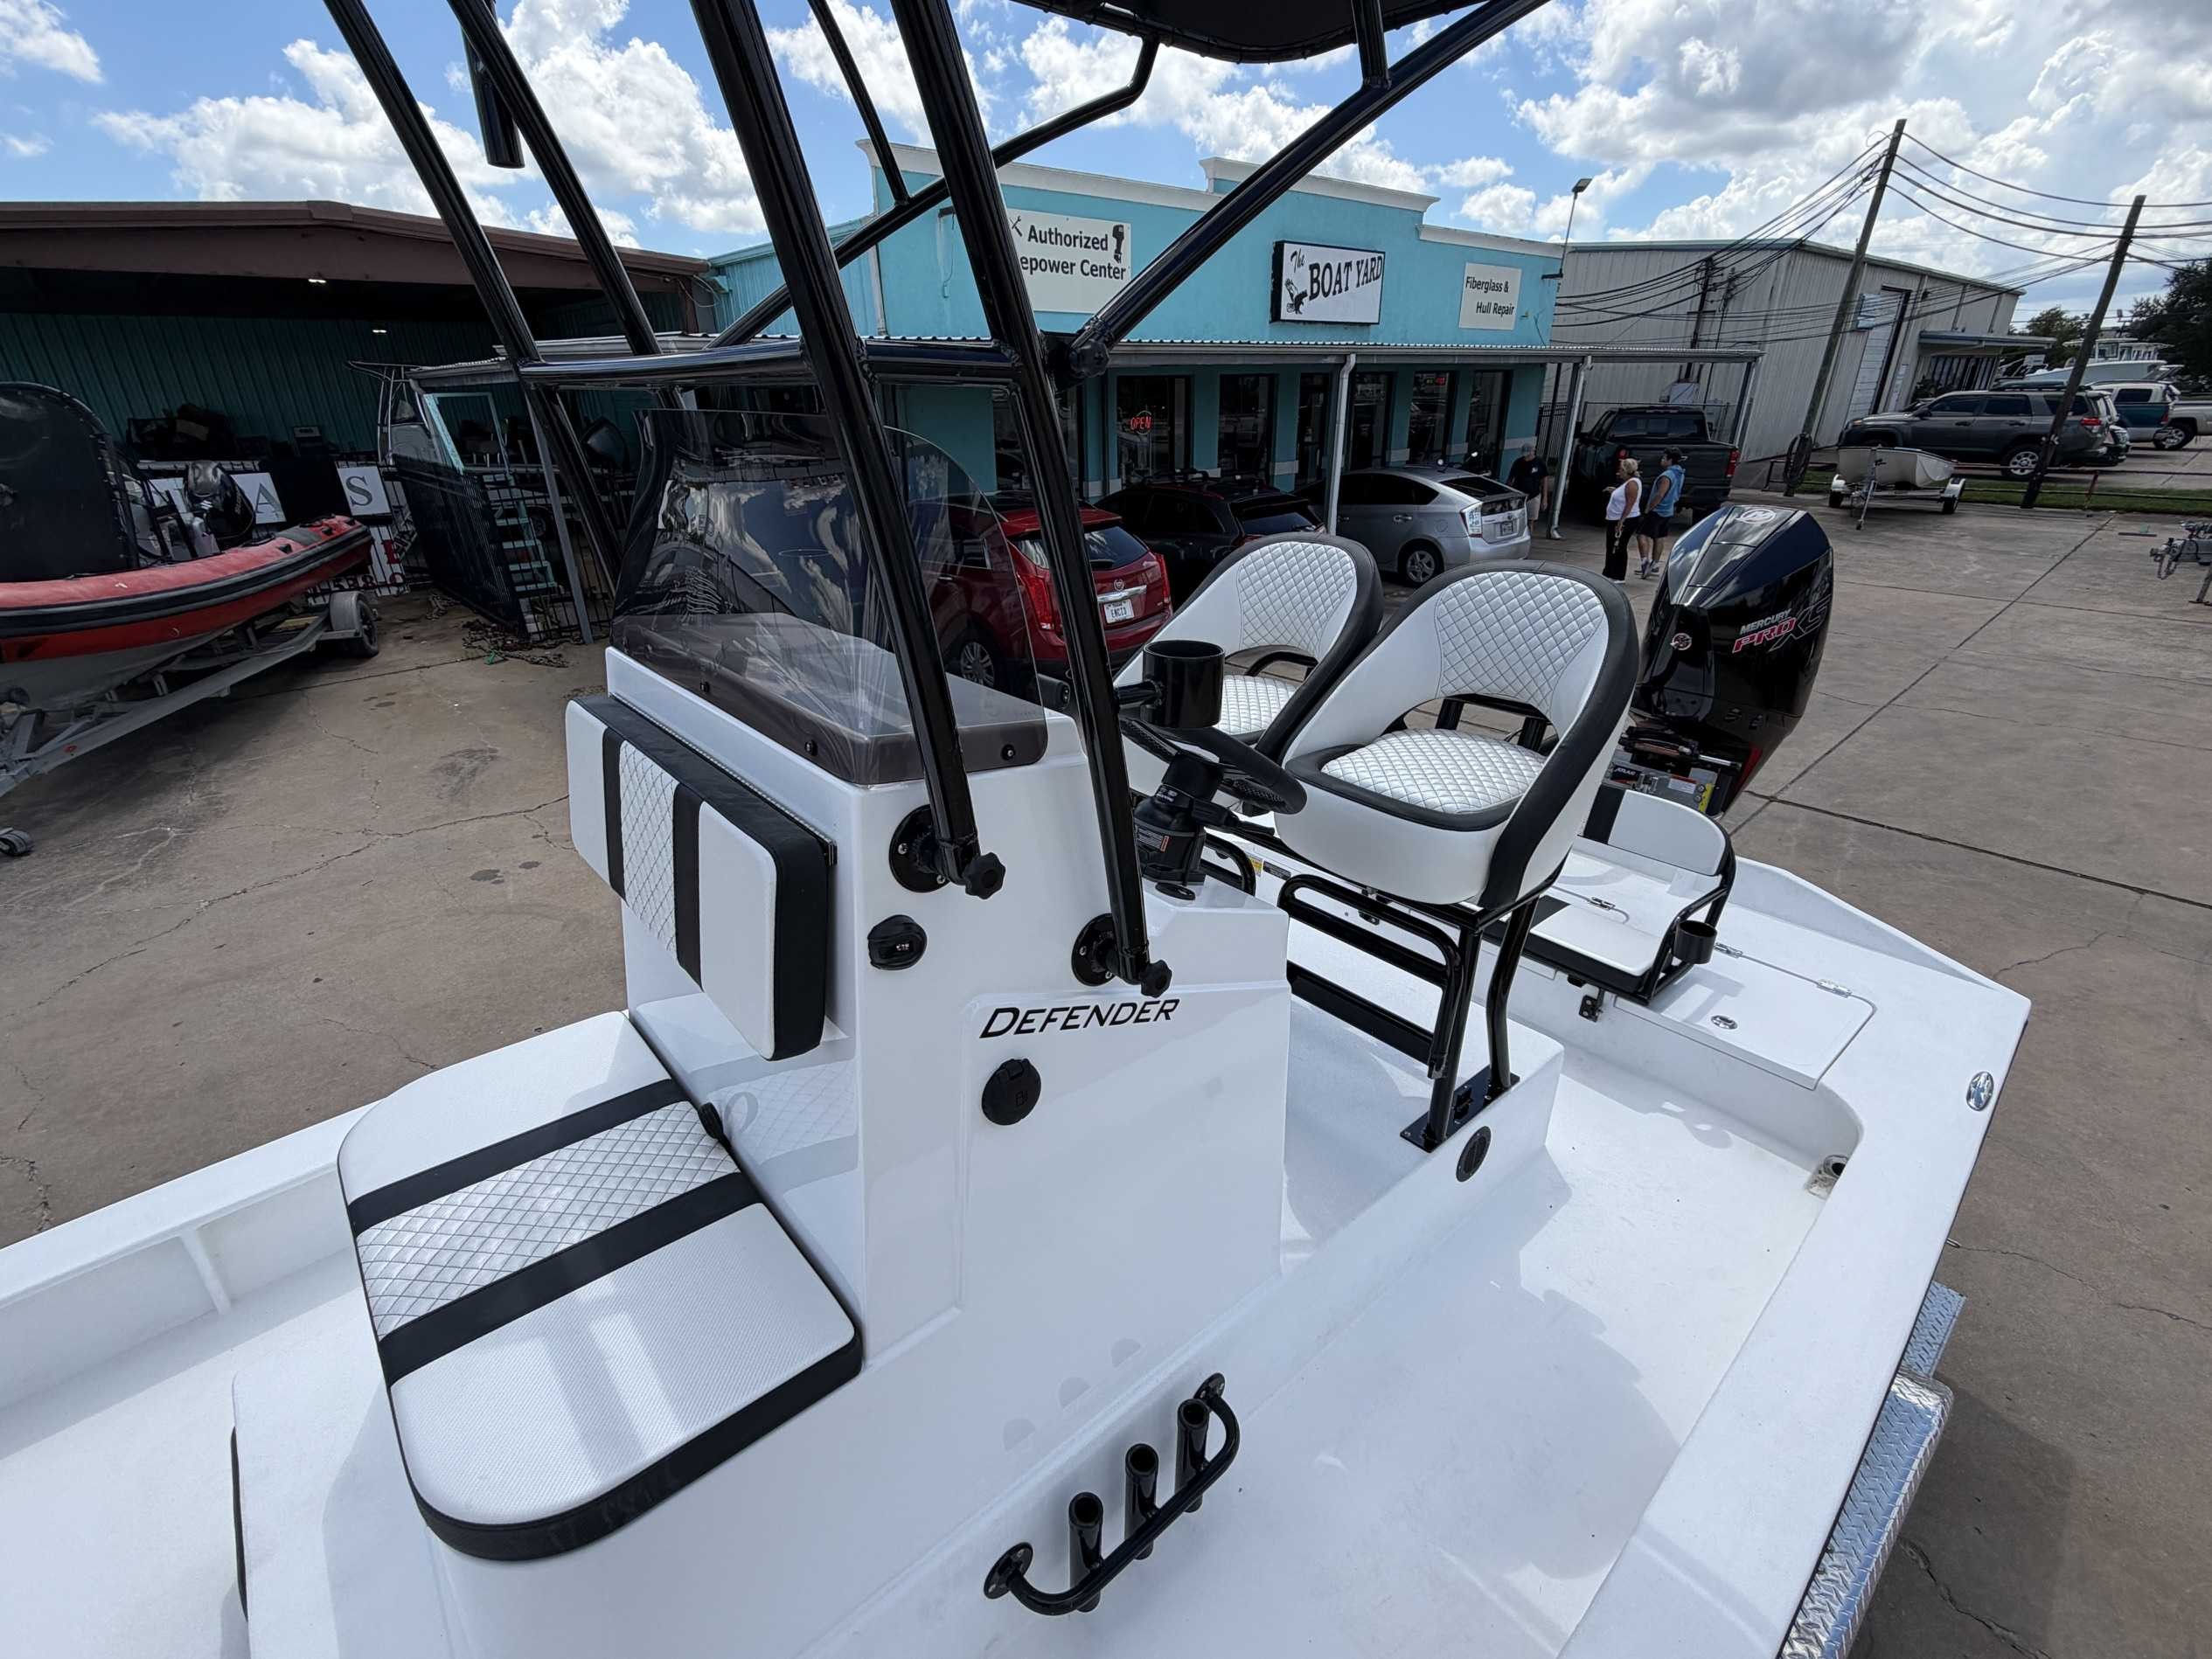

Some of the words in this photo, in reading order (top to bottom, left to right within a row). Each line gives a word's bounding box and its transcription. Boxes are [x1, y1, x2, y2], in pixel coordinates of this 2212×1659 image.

[1027, 225, 1109, 251] Authorized
[1019, 255, 1076, 274] epower
[1080, 259, 1127, 281] Center
[1290, 248, 1305, 273] The
[1309, 261, 1353, 302] BOAT
[1356, 255, 1383, 288] YARD
[1465, 276, 1503, 293] Fiberglass
[1504, 281, 1509, 293] &
[1476, 302, 1492, 314] Hull
[1493, 303, 1515, 317] Repair
[1130, 416, 1151, 430] OPEN
[345, 475, 372, 506] S
[1740, 608, 1792, 635] MERCURY
[979, 998, 1180, 1039] DEFENDER
